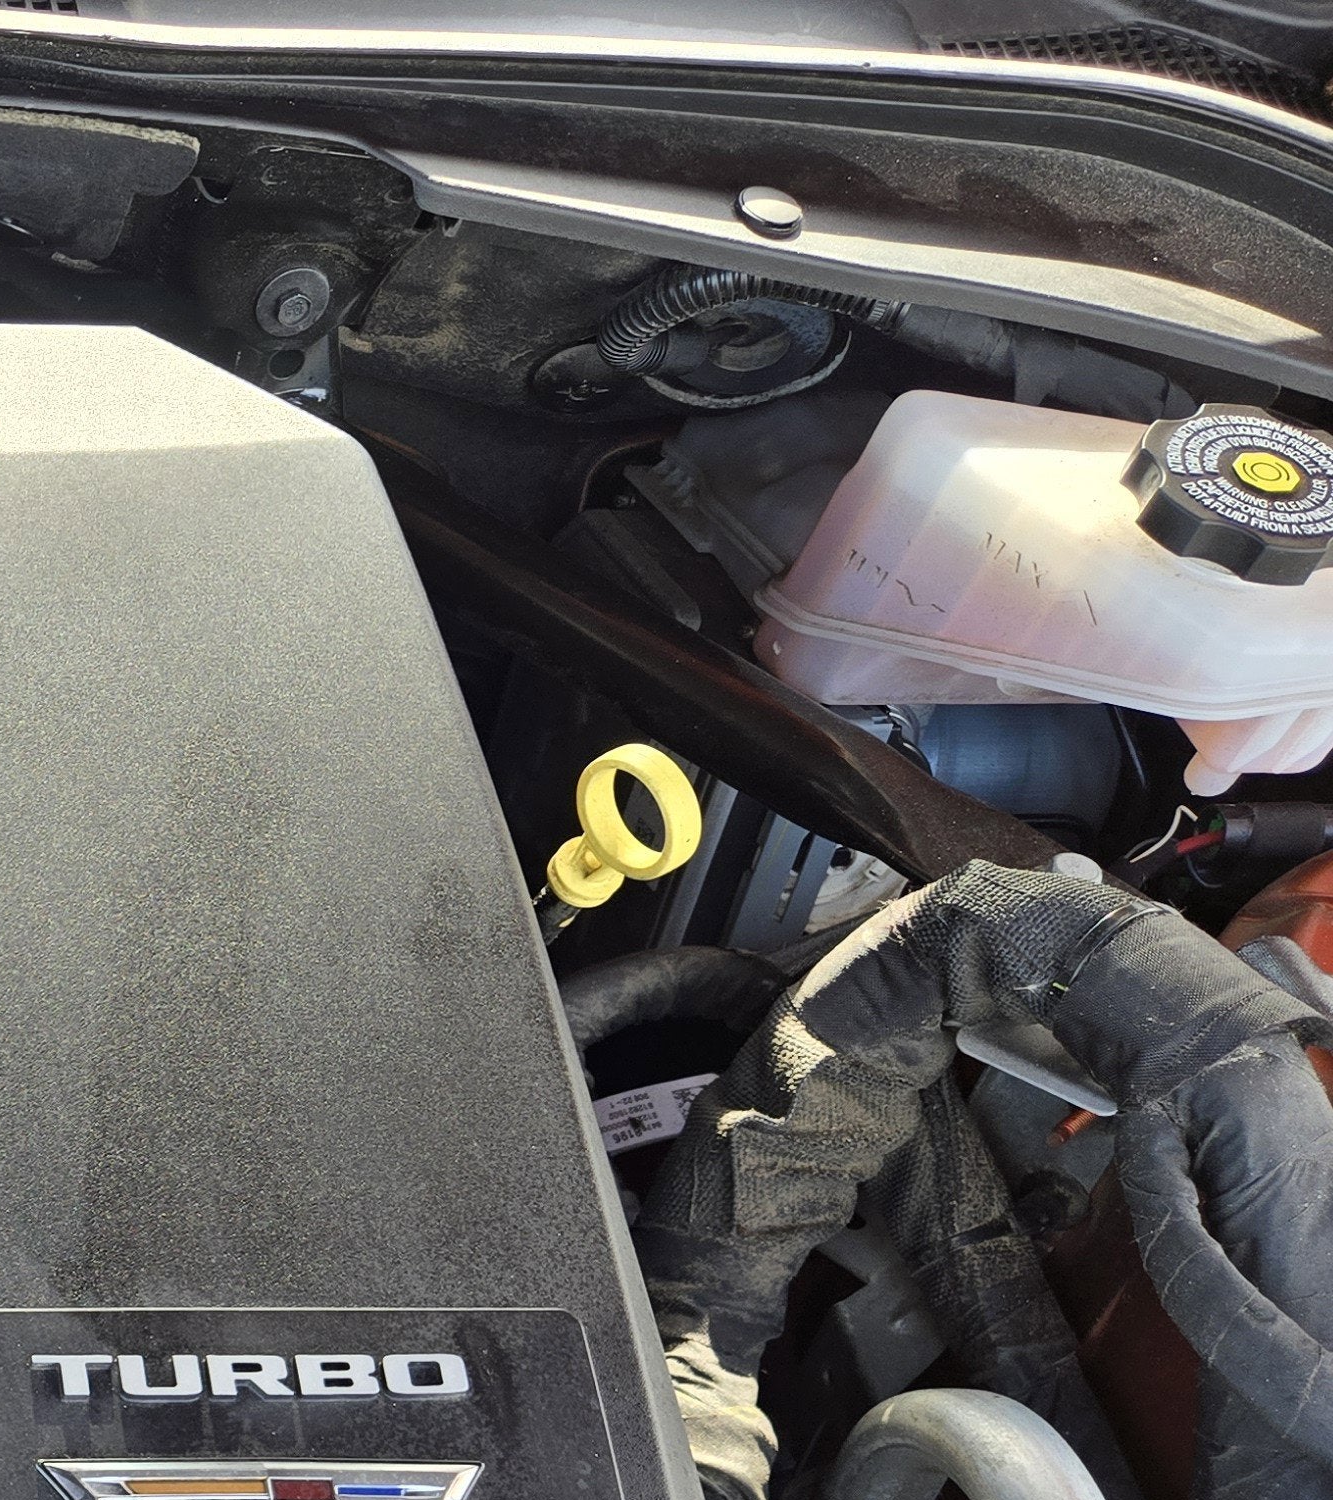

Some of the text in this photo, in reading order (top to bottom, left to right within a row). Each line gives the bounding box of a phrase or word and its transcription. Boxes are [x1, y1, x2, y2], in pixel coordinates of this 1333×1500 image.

[1228, 415, 1281, 430] BOUCHON
[1280, 424, 1319, 446] AVANT
[1232, 425, 1273, 439] LIQUIDE
[1272, 431, 1288, 444] DE
[1252, 436, 1286, 453] BIDON
[1181, 482, 1209, 501] DOT
[1209, 501, 1249, 523] FLUID
[1250, 517, 1290, 534] FROM
[1292, 525, 1303, 535] A
[1196, 479, 1224, 497] CAP
[1217, 494, 1269, 519] BEFORE
[1274, 497, 1315, 512] CLEAN
[31, 1353, 470, 1399] TURBO
